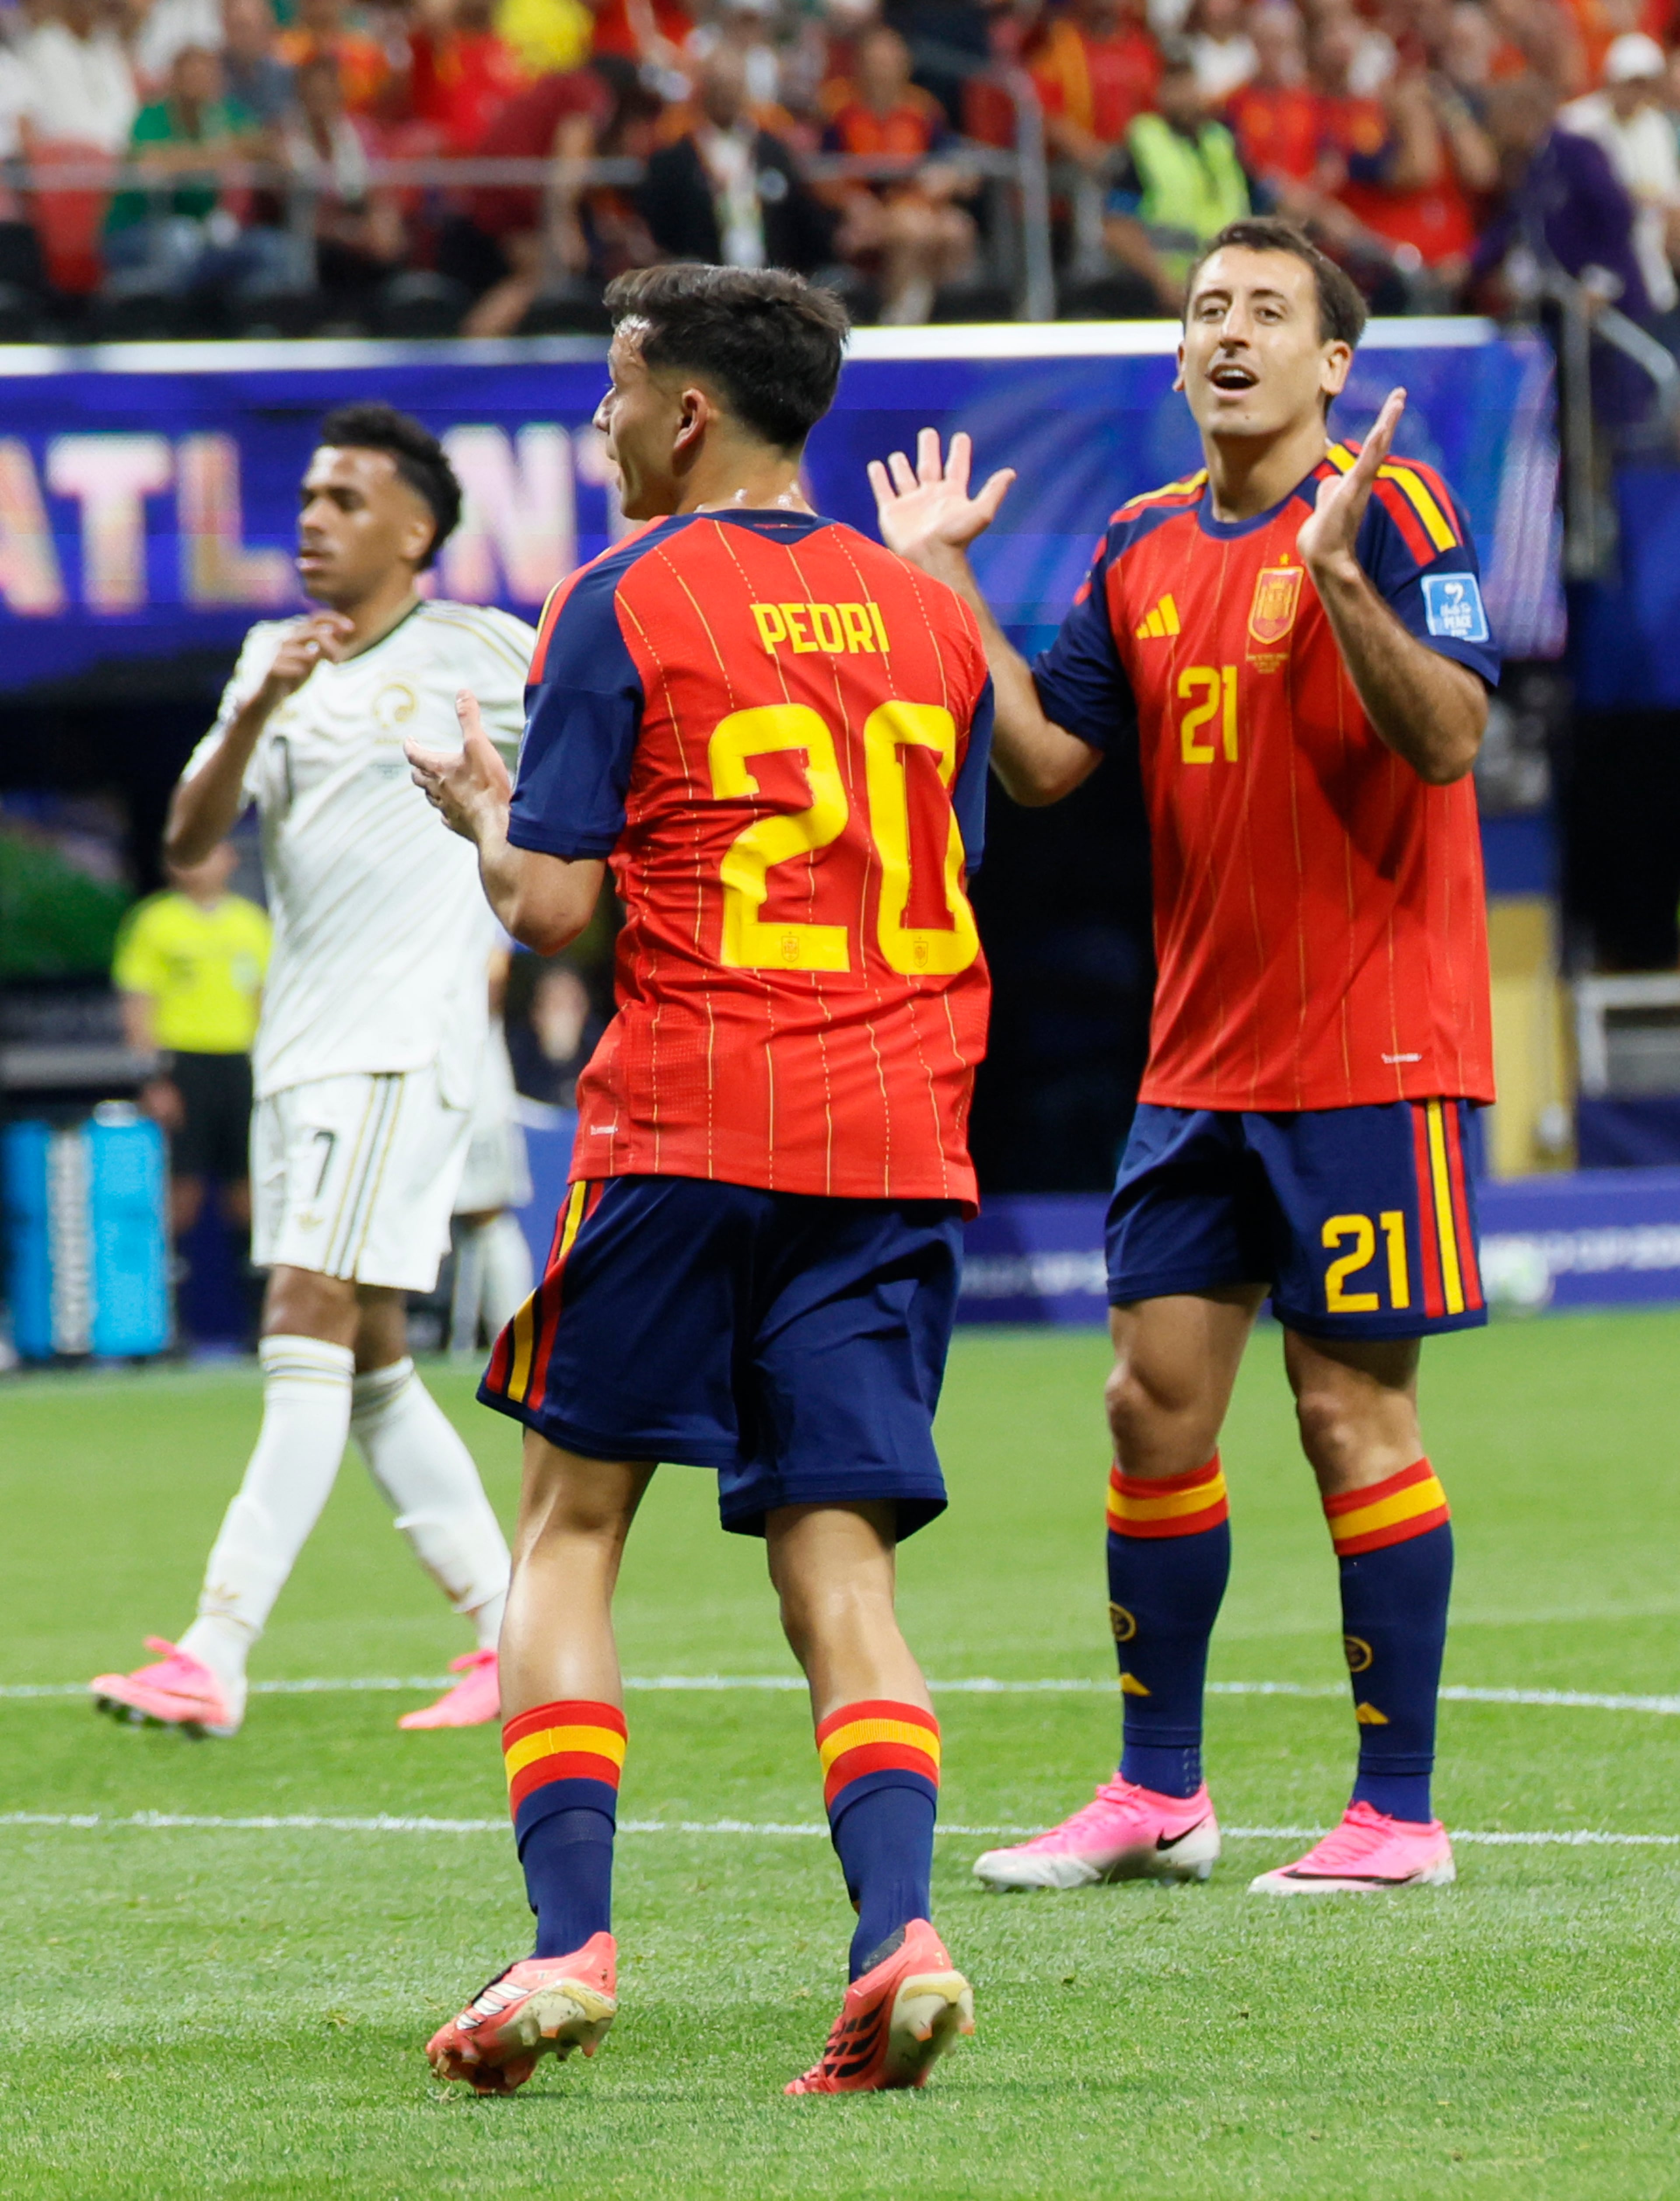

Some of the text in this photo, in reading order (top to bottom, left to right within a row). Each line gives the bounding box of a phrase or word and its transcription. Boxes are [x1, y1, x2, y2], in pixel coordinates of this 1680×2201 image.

[749, 602, 890, 654] PEDRI
[1177, 665, 1239, 764] 21
[708, 700, 980, 976] 20
[313, 1130, 336, 1198] 7
[1322, 1209, 1410, 1313] 21
